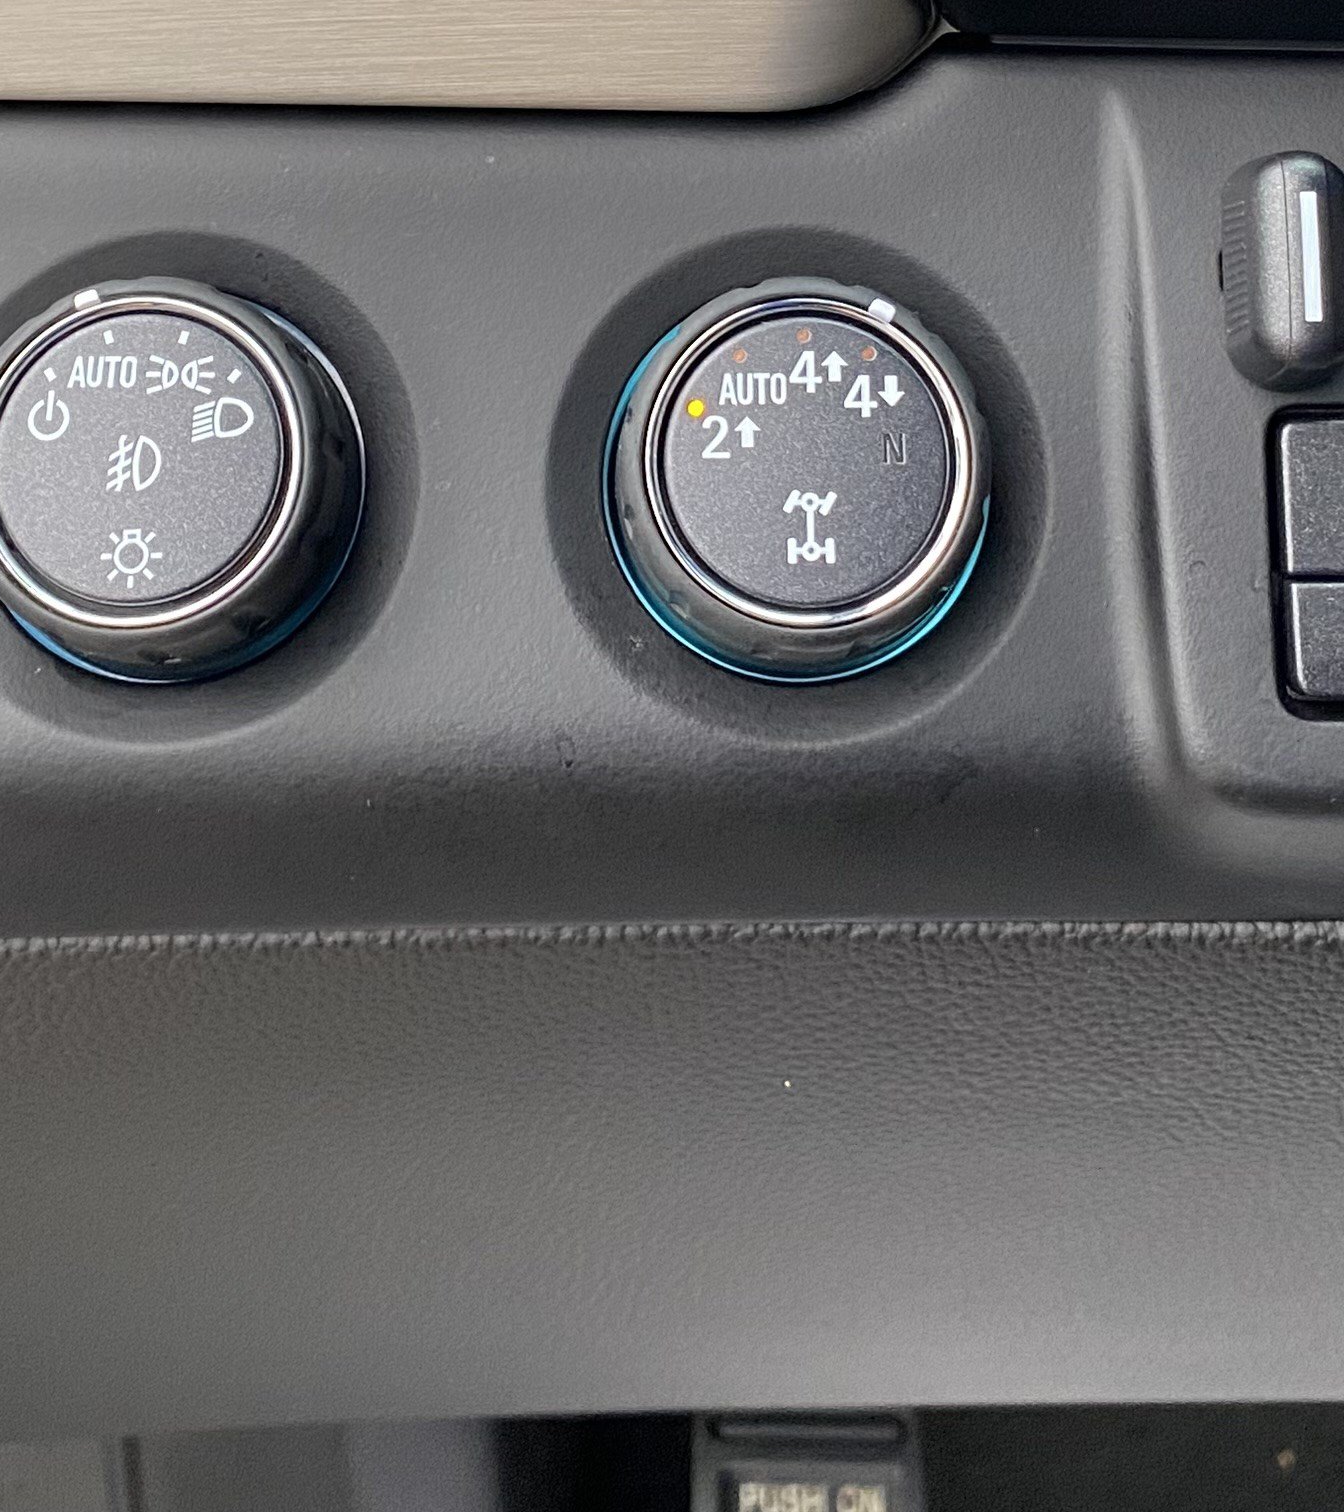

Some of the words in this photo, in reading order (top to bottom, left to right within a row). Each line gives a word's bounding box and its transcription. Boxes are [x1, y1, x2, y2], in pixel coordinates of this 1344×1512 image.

[67, 355, 137, 388] AUTO
[718, 372, 787, 405] AUTO
[789, 350, 823, 393] 4
[844, 374, 878, 418] 4
[701, 415, 731, 459] 2
[882, 432, 907, 466] N
